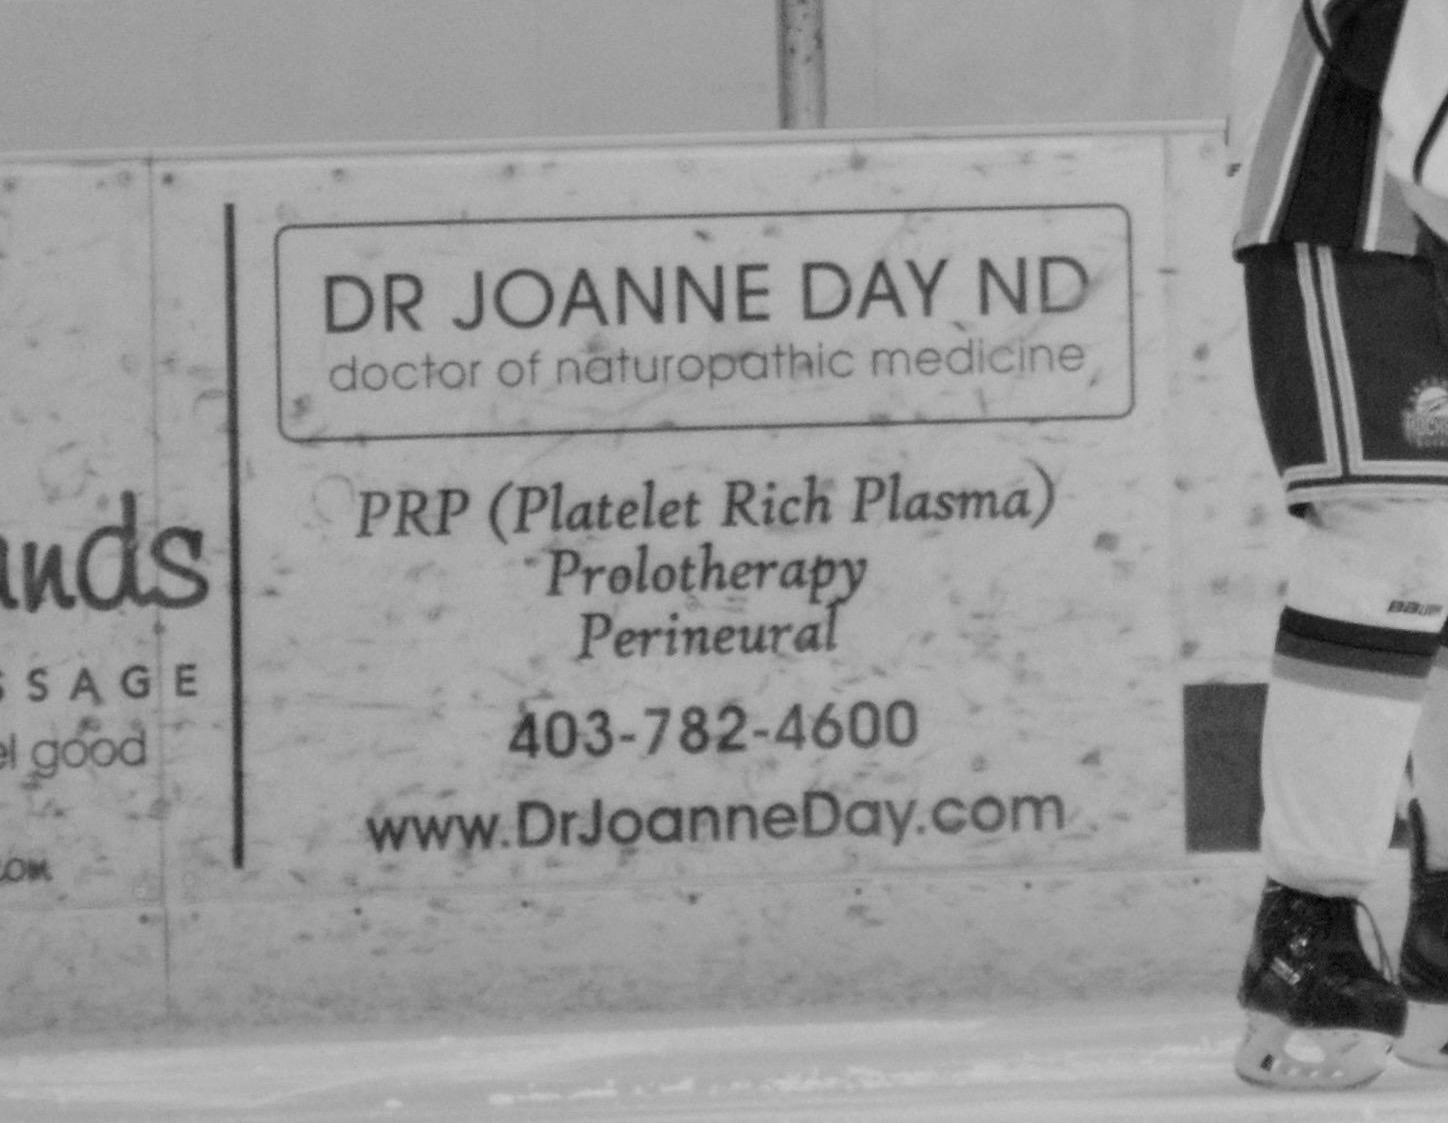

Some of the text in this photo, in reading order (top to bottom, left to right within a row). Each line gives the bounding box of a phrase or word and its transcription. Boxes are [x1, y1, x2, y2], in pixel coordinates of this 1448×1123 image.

[324, 256, 1090, 334] DR JOANNE DAY ND
[330, 338, 1086, 392] doctor of naturopathic medicine
[356, 460, 1056, 544] PRP (Platelet Rich Plasma)
[546, 542, 868, 604] Prolotherapy
[576, 602, 838, 660] Perineural
[0, 663, 198, 706] SAGE
[31, 731, 147, 780] good
[508, 698, 918, 759] 403-782-4600
[367, 789, 1066, 852] www.DrJoanneDay.com
